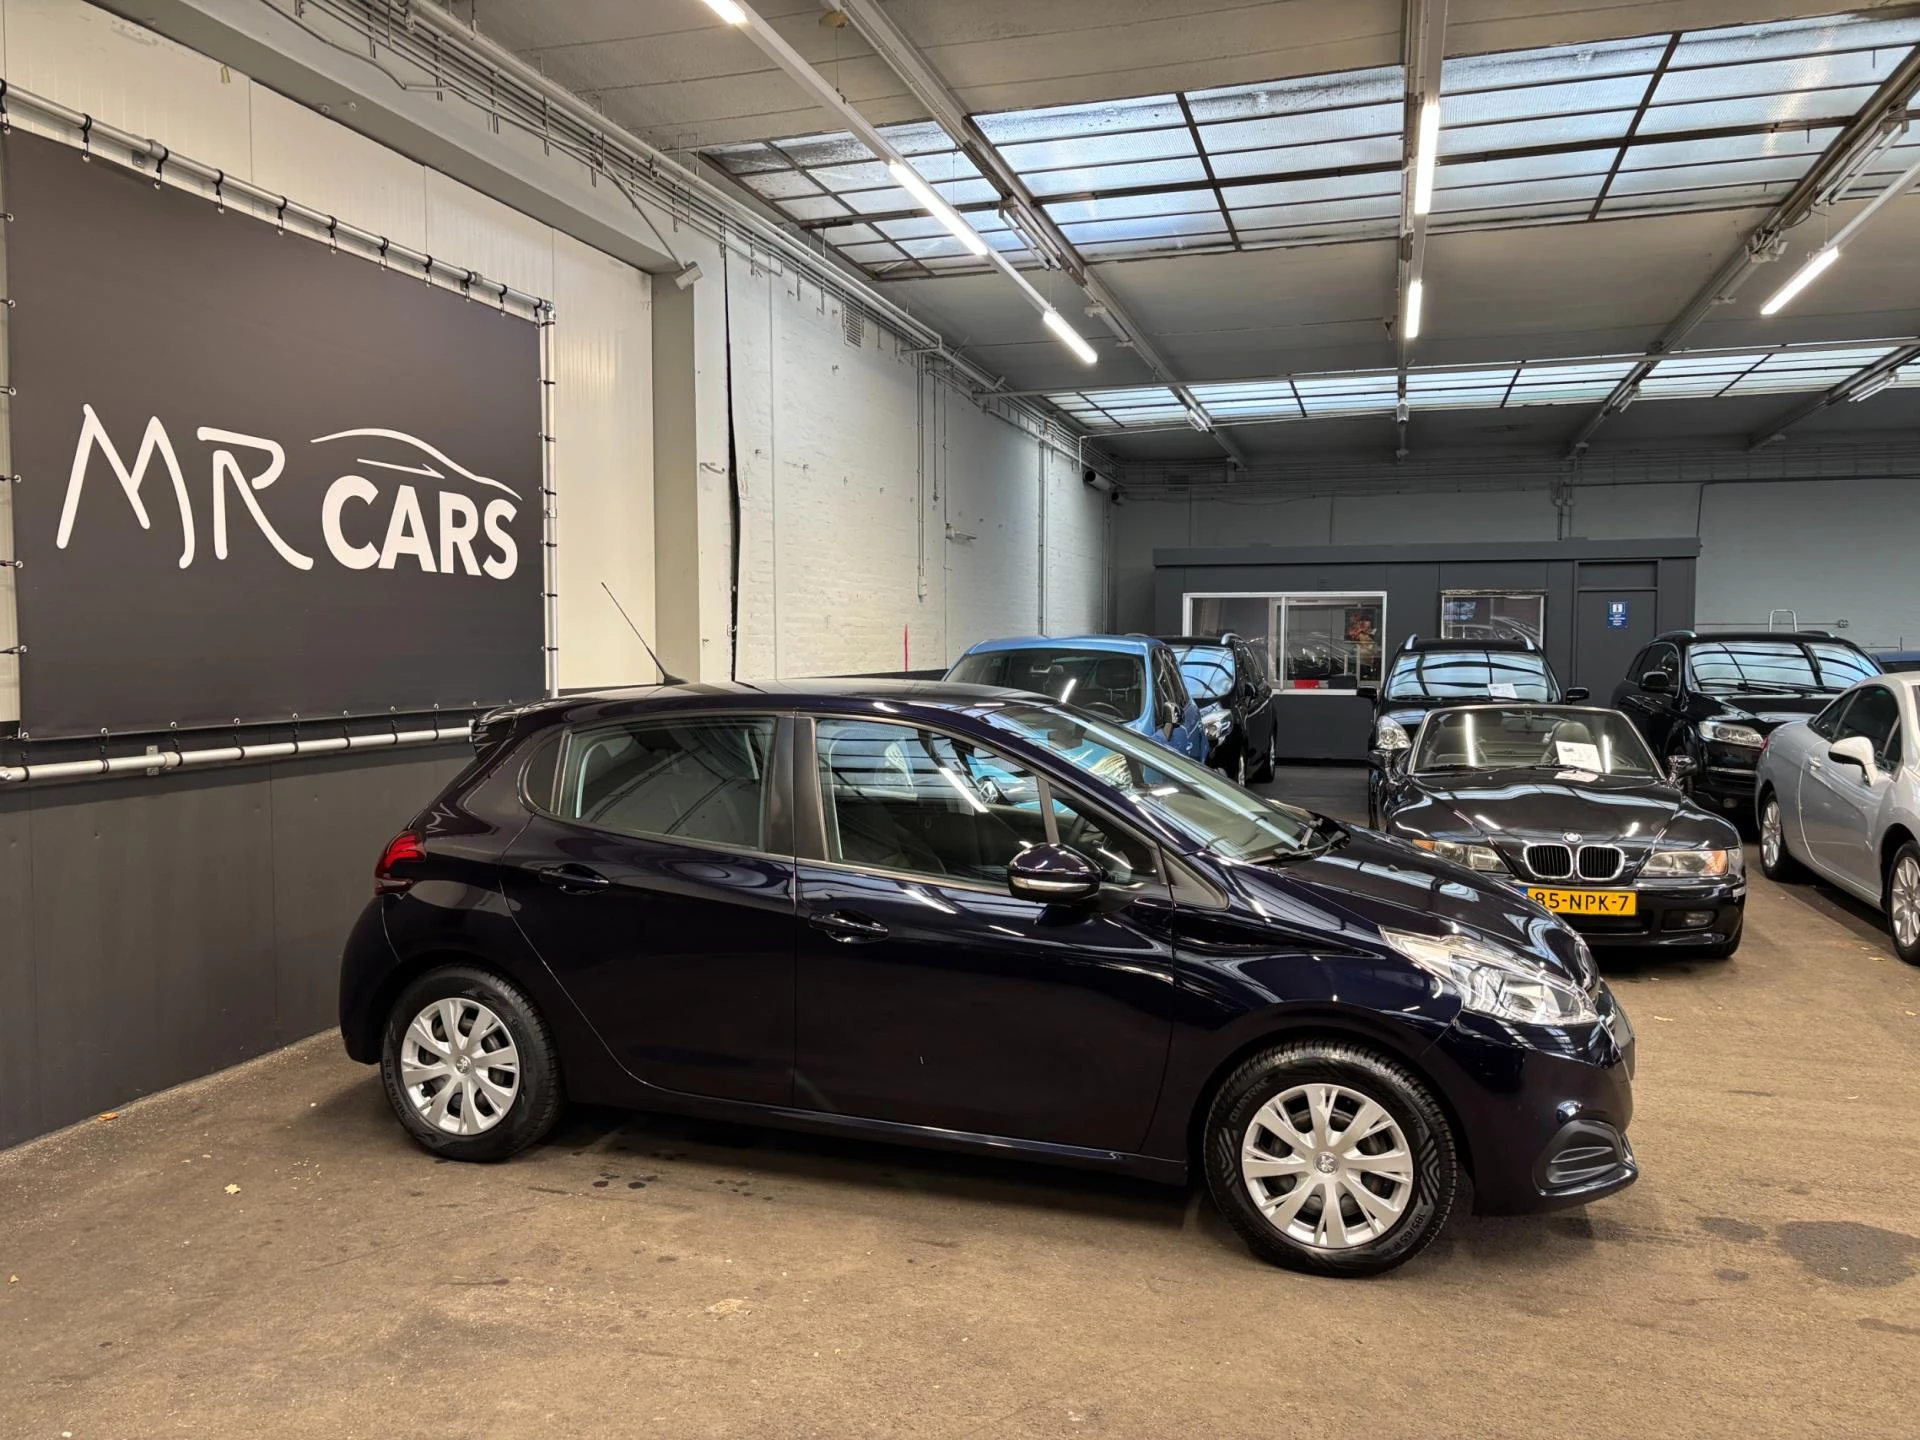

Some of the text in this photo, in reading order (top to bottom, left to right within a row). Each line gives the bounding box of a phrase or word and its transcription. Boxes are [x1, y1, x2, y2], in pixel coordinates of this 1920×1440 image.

[56, 403, 519, 580] MR CARS
[1535, 892, 1629, 911] 85-NPK-7
[1229, 1077, 1270, 1123] QUATRAC
